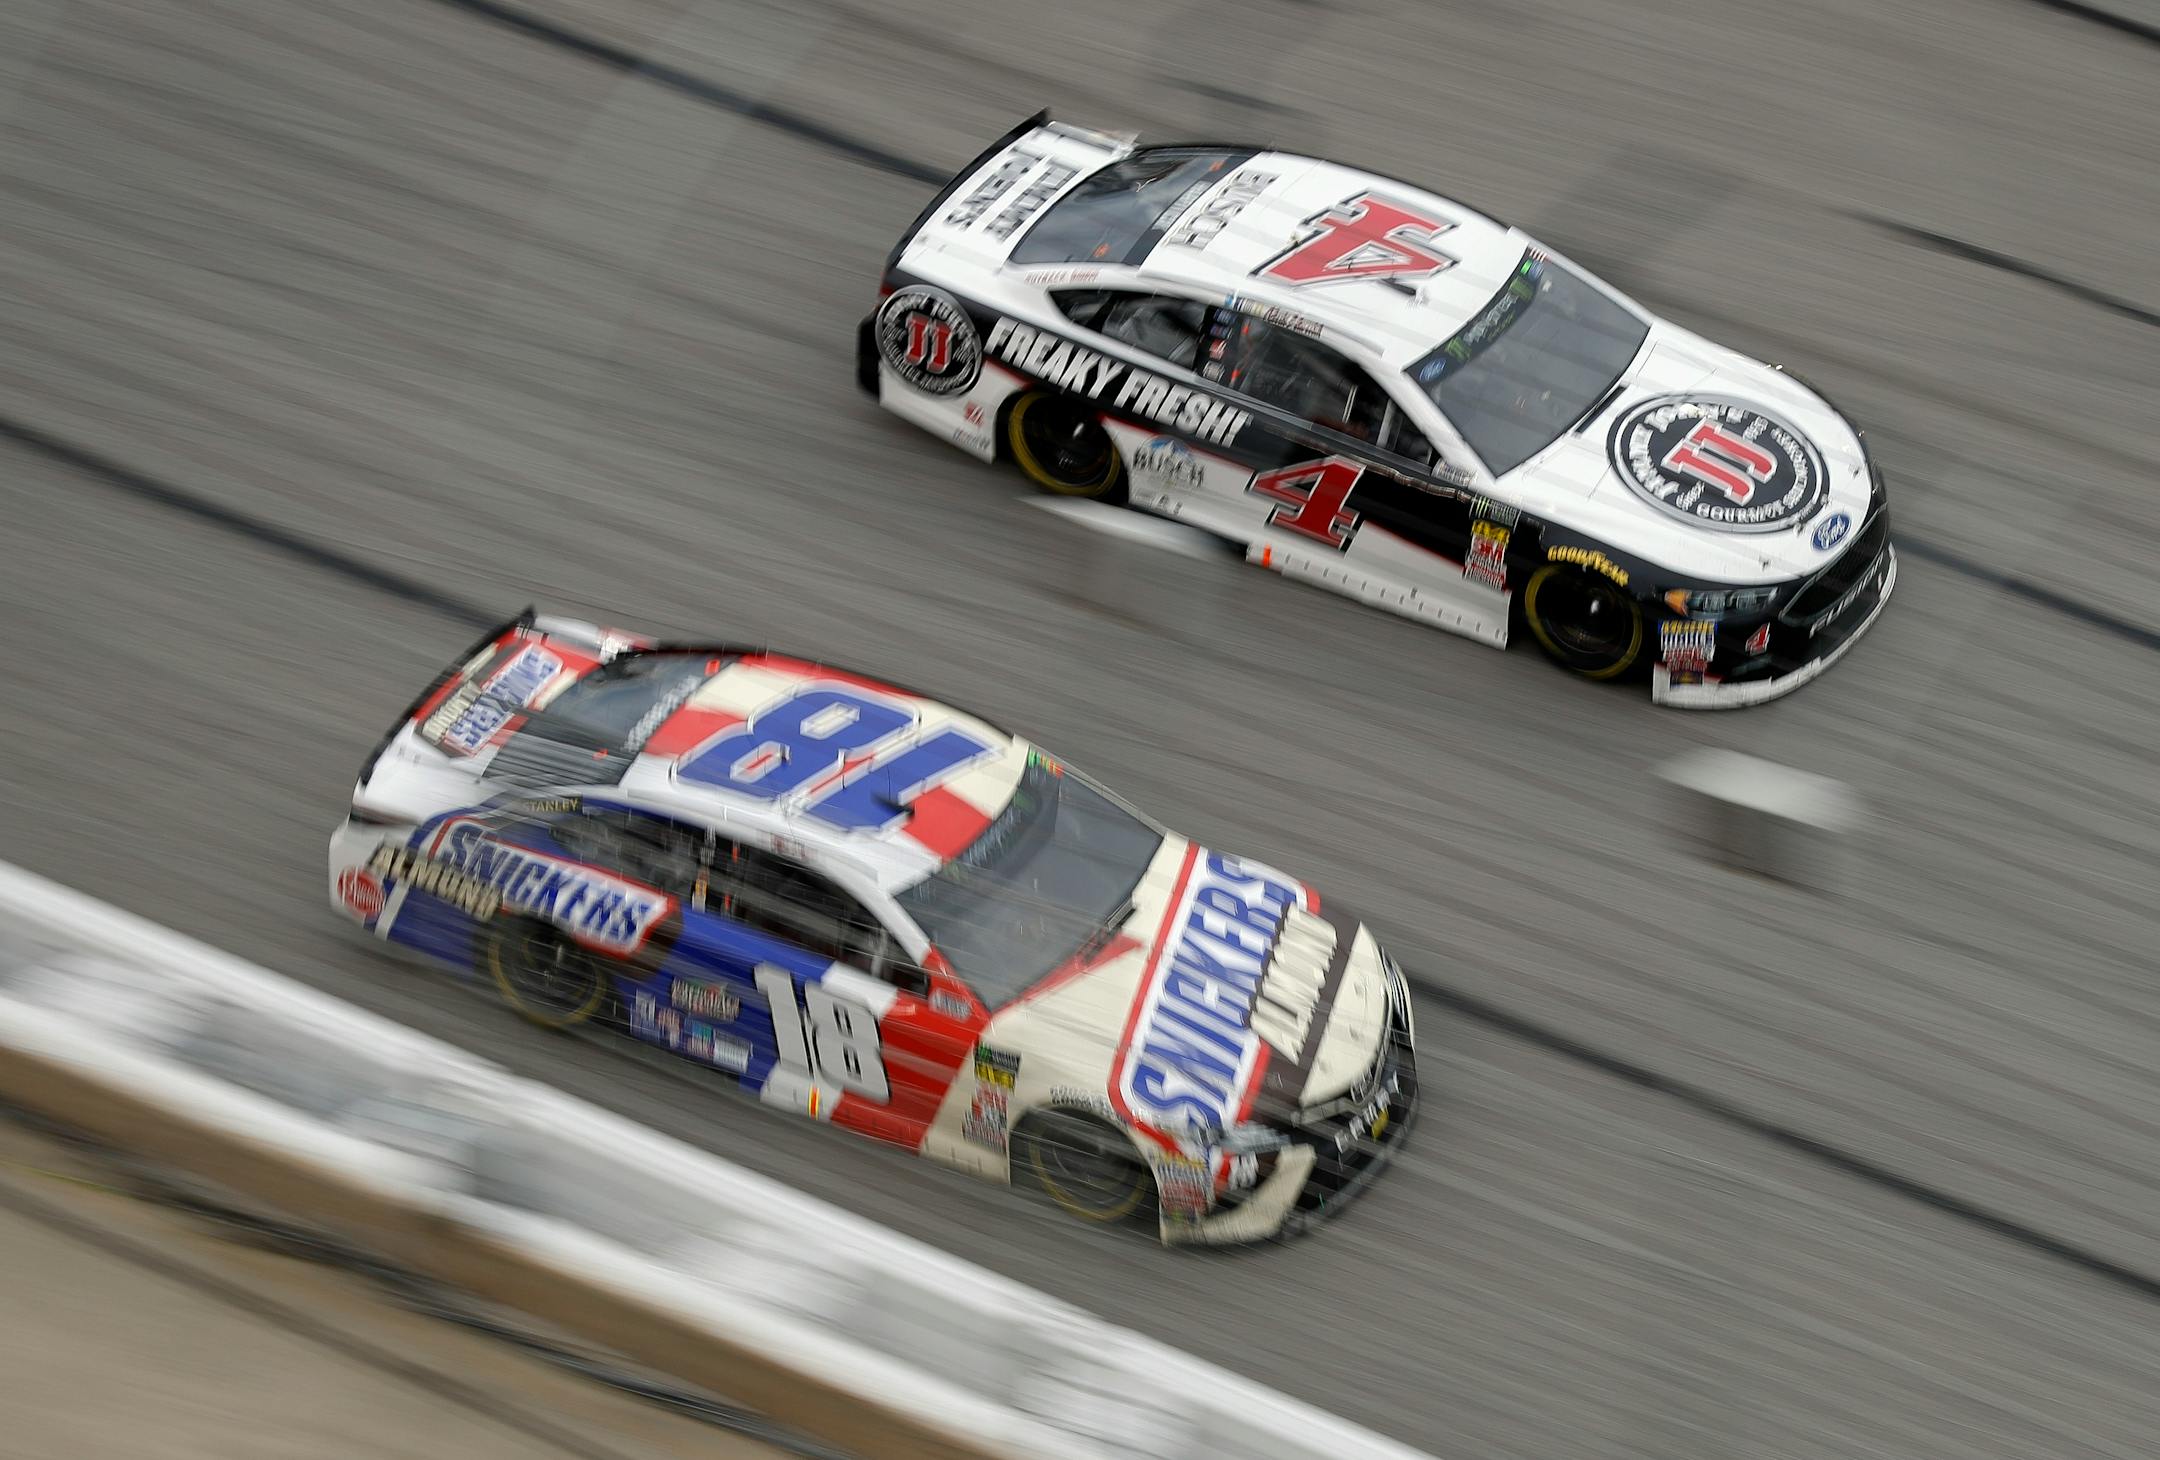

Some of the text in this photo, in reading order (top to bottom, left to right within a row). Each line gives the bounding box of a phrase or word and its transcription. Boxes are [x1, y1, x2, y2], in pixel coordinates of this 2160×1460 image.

[1250, 190, 1458, 289] 4
[984, 317, 1123, 399] FREAKY
[1113, 369, 1252, 446] FRESH!
[1245, 455, 1366, 552] 4
[672, 680, 1000, 832] 18
[450, 824, 658, 942] SNICKERS
[754, 962, 891, 1104] 18
[1132, 851, 1298, 1134] SNICKERS
